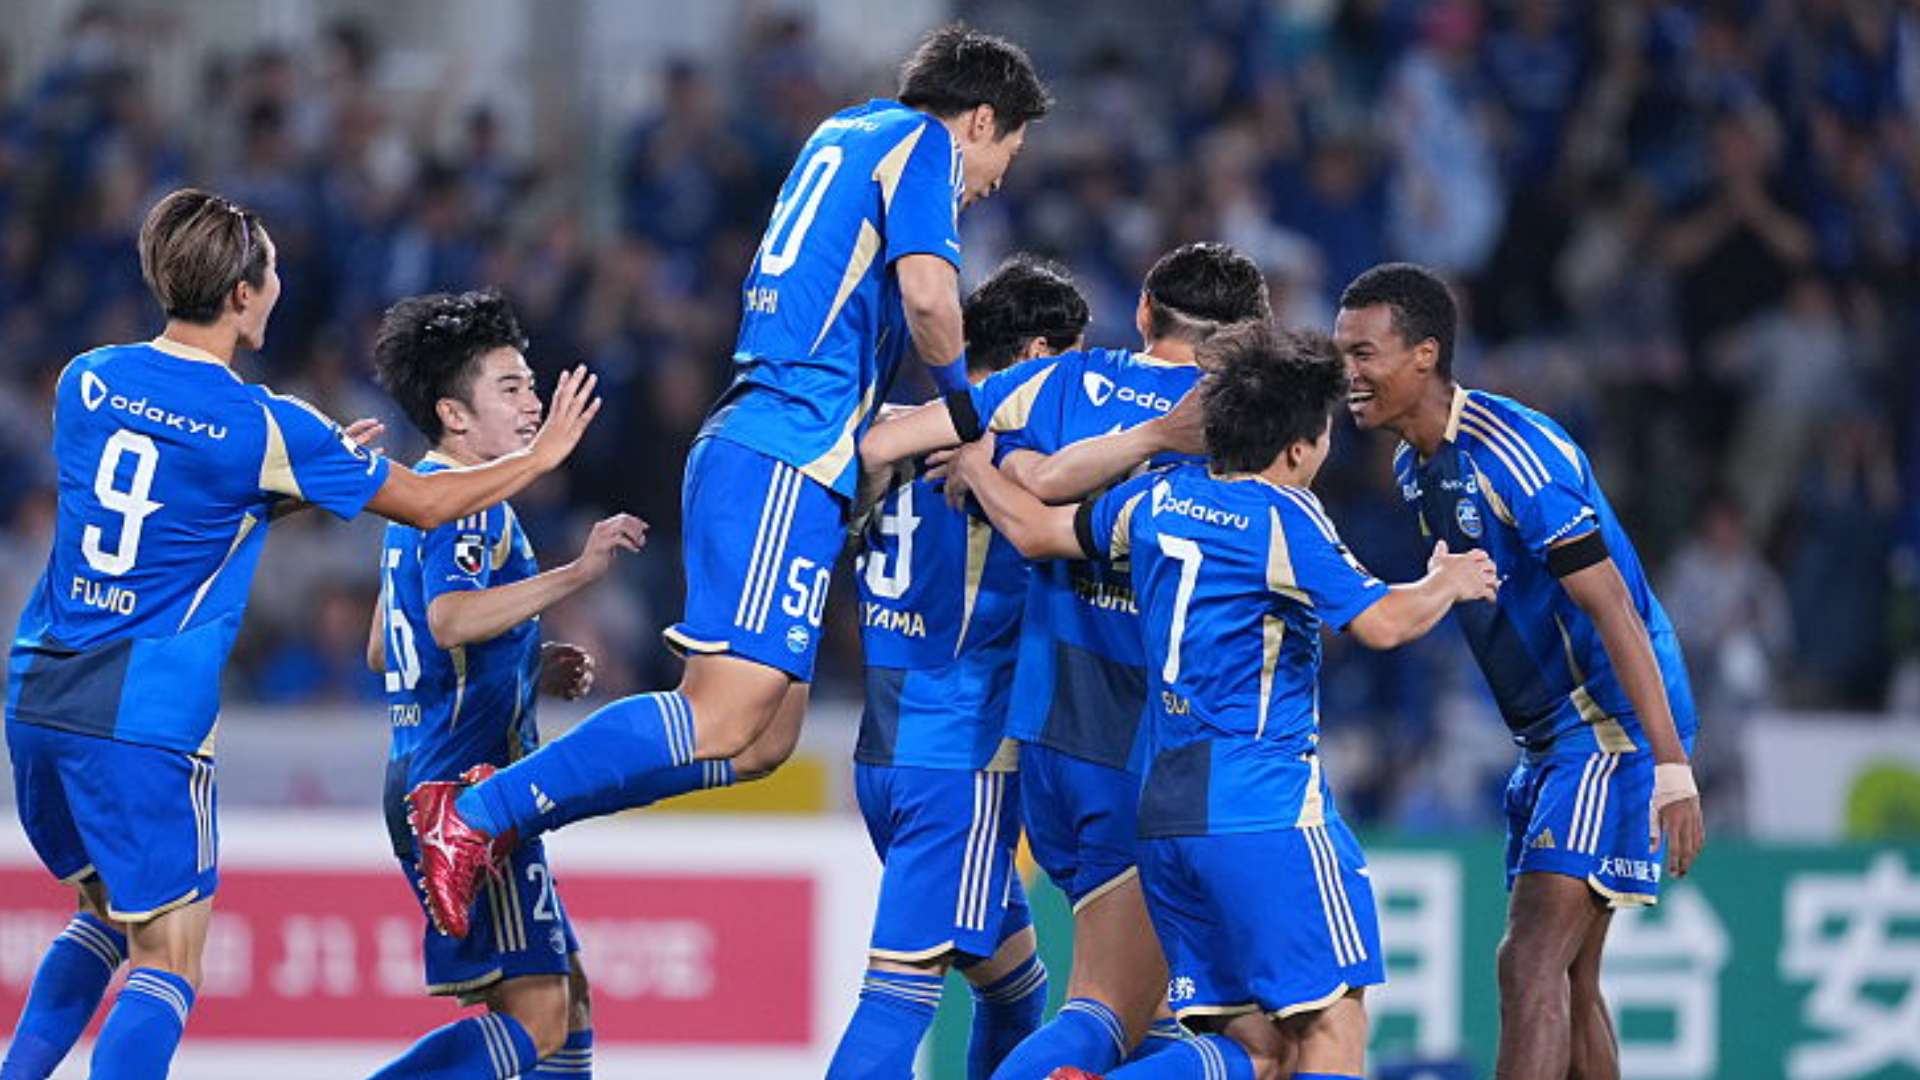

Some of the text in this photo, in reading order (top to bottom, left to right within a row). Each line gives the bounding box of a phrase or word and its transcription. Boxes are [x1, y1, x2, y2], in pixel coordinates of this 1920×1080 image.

[758, 145, 844, 277] 0
[109, 395, 229, 441] odakyu
[1117, 386, 1173, 412] oda
[80, 427, 165, 577] 9
[856, 480, 923, 600] 9
[70, 576, 137, 617] FUJIO
[381, 547, 422, 693] 6
[781, 556, 832, 628] 50
[1156, 532, 1204, 685] 7
[526, 862, 561, 922] 2
